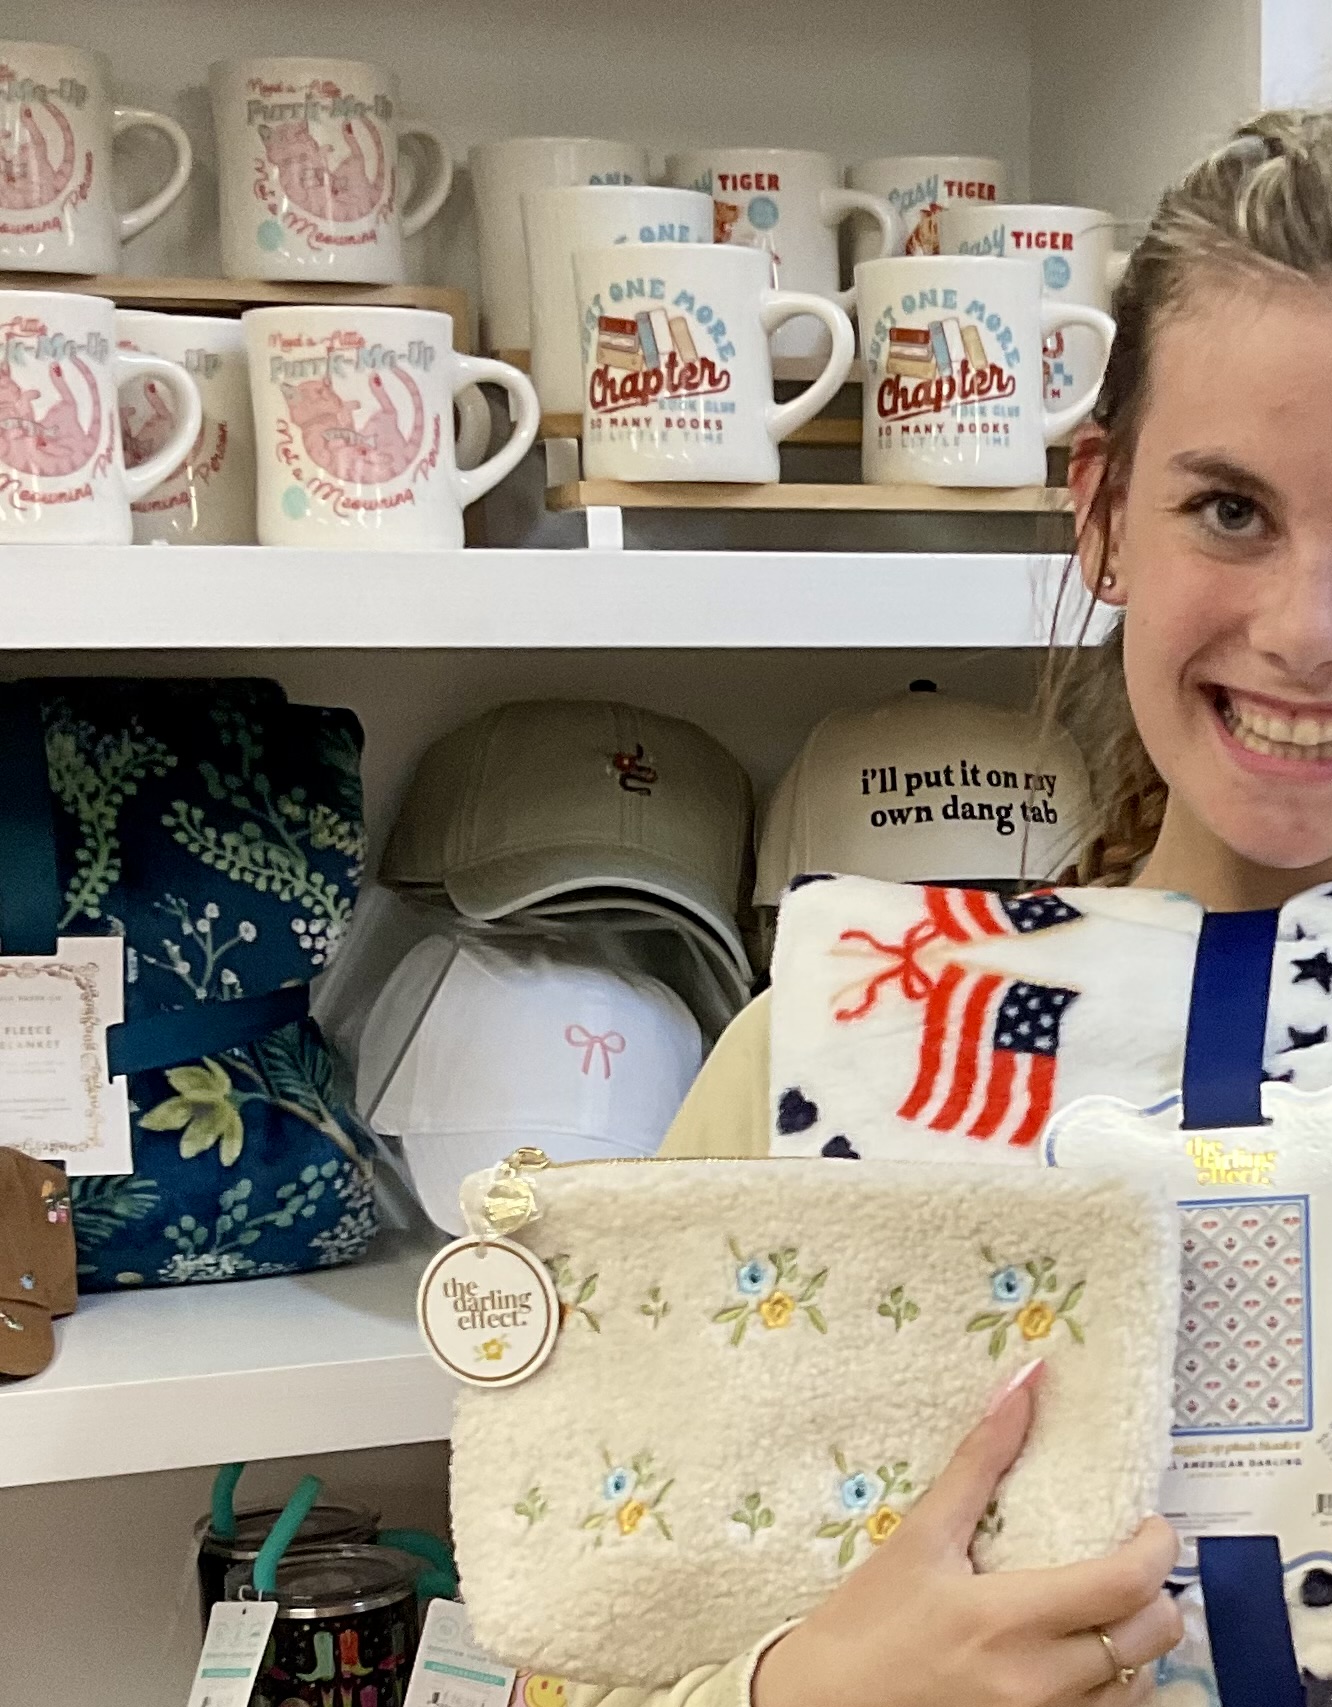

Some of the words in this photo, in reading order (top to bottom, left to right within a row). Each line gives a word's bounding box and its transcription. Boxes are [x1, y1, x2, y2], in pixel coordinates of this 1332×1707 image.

[717, 173, 781, 192] TIGER
[944, 180, 996, 201] TIGER
[1011, 231, 1073, 250] TIGER
[609, 278, 667, 302] ONE
[672, 289, 737, 363] MORE
[901, 288, 957, 315] ONE
[964, 300, 1021, 369] MORE
[589, 350, 731, 412] Chapter
[877, 358, 1016, 422] Chapter
[609, 417, 652, 430] MANY
[664, 418, 724, 431] BOOKS
[901, 424, 945, 434] MANY
[957, 423, 1011, 434] BOOKS
[861, 766, 898, 796] i'll
[904, 764, 956, 797] put
[960, 759, 982, 787] it
[986, 769, 1019, 789] on
[1023, 772, 1057, 798] my
[870, 805, 934, 828] own
[941, 794, 1016, 836] dang
[1020, 799, 1059, 825] tab
[4, 1026, 54, 1036] FLEECE
[442, 1277, 479, 1299] the
[452, 1290, 533, 1315] darling
[456, 1307, 529, 1331] effect.
[1182, 1458, 1245, 1470] AMERICAN
[1248, 1457, 1303, 1468] DARLING
